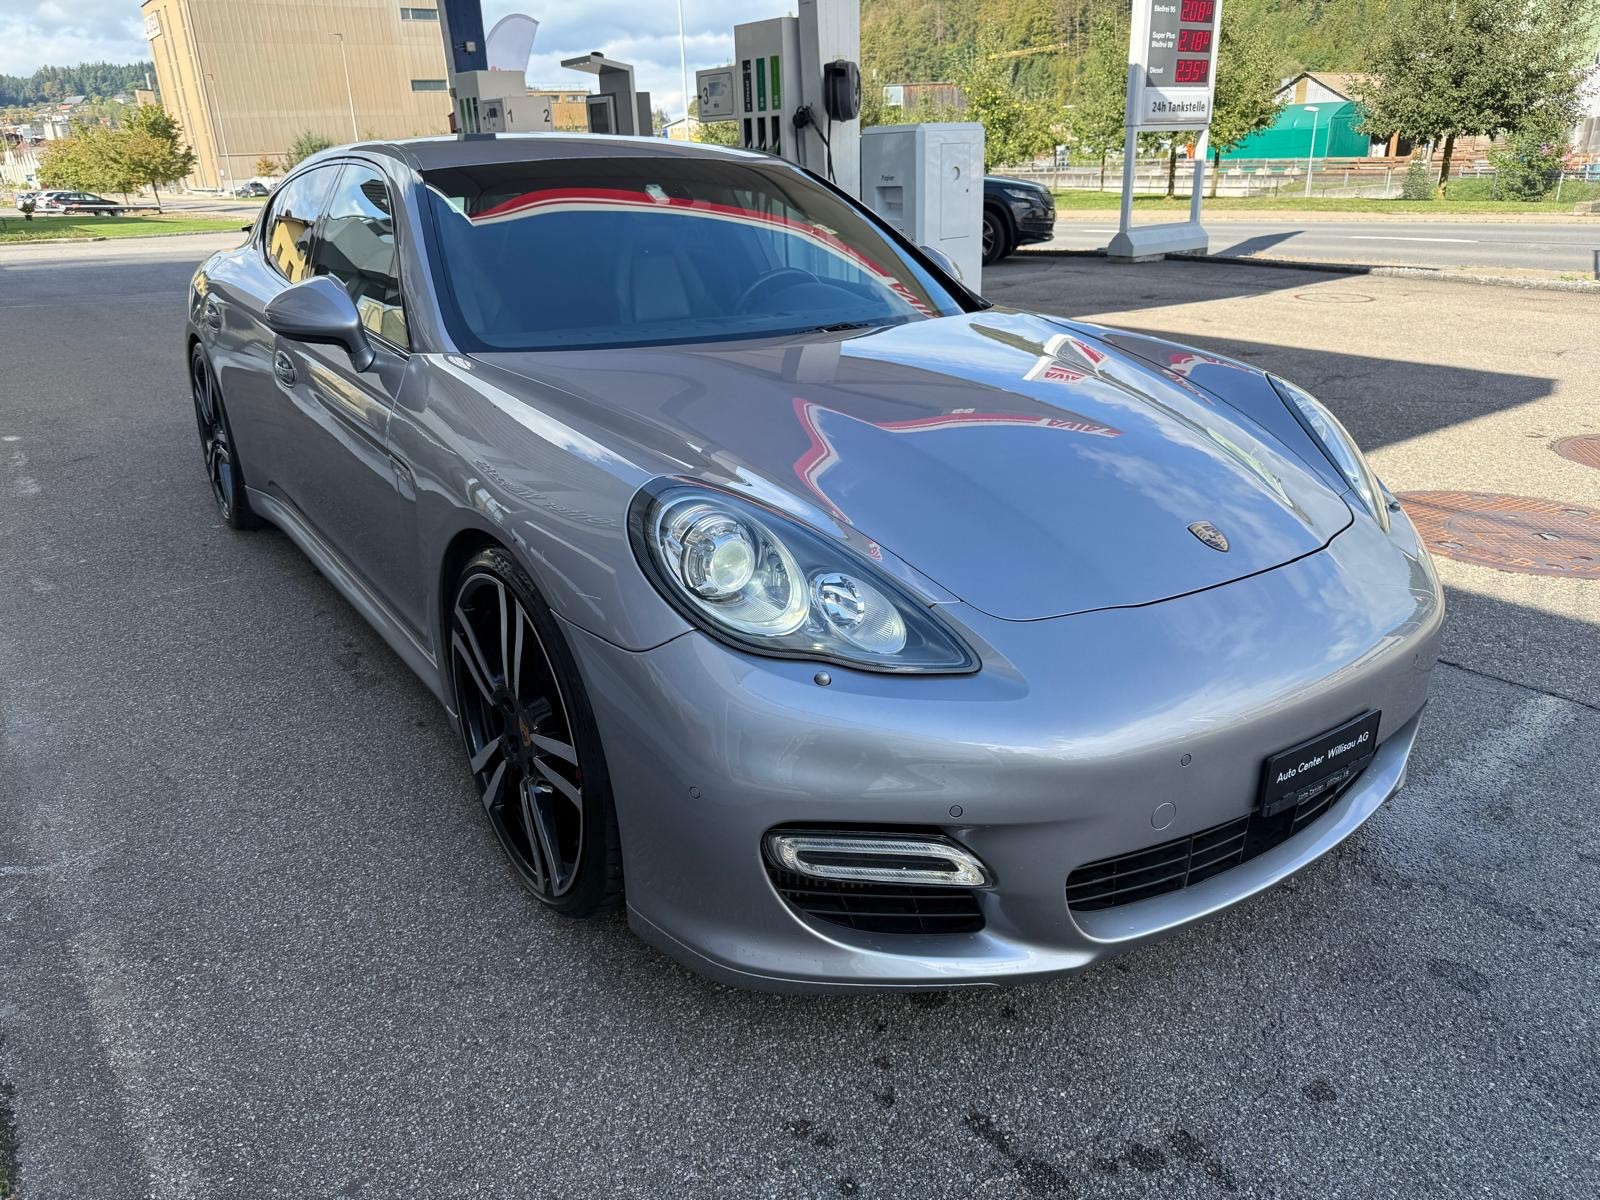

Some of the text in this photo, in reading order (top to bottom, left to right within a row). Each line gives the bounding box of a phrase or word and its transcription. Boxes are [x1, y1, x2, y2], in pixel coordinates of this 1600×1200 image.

[703, 87, 709, 105] 3
[1152, 101, 1206, 113] 24h Tankstelle
[507, 109, 514, 123] 1
[543, 109, 551, 123] 2
[1276, 731, 1369, 784] Auto Center Willisau AG
